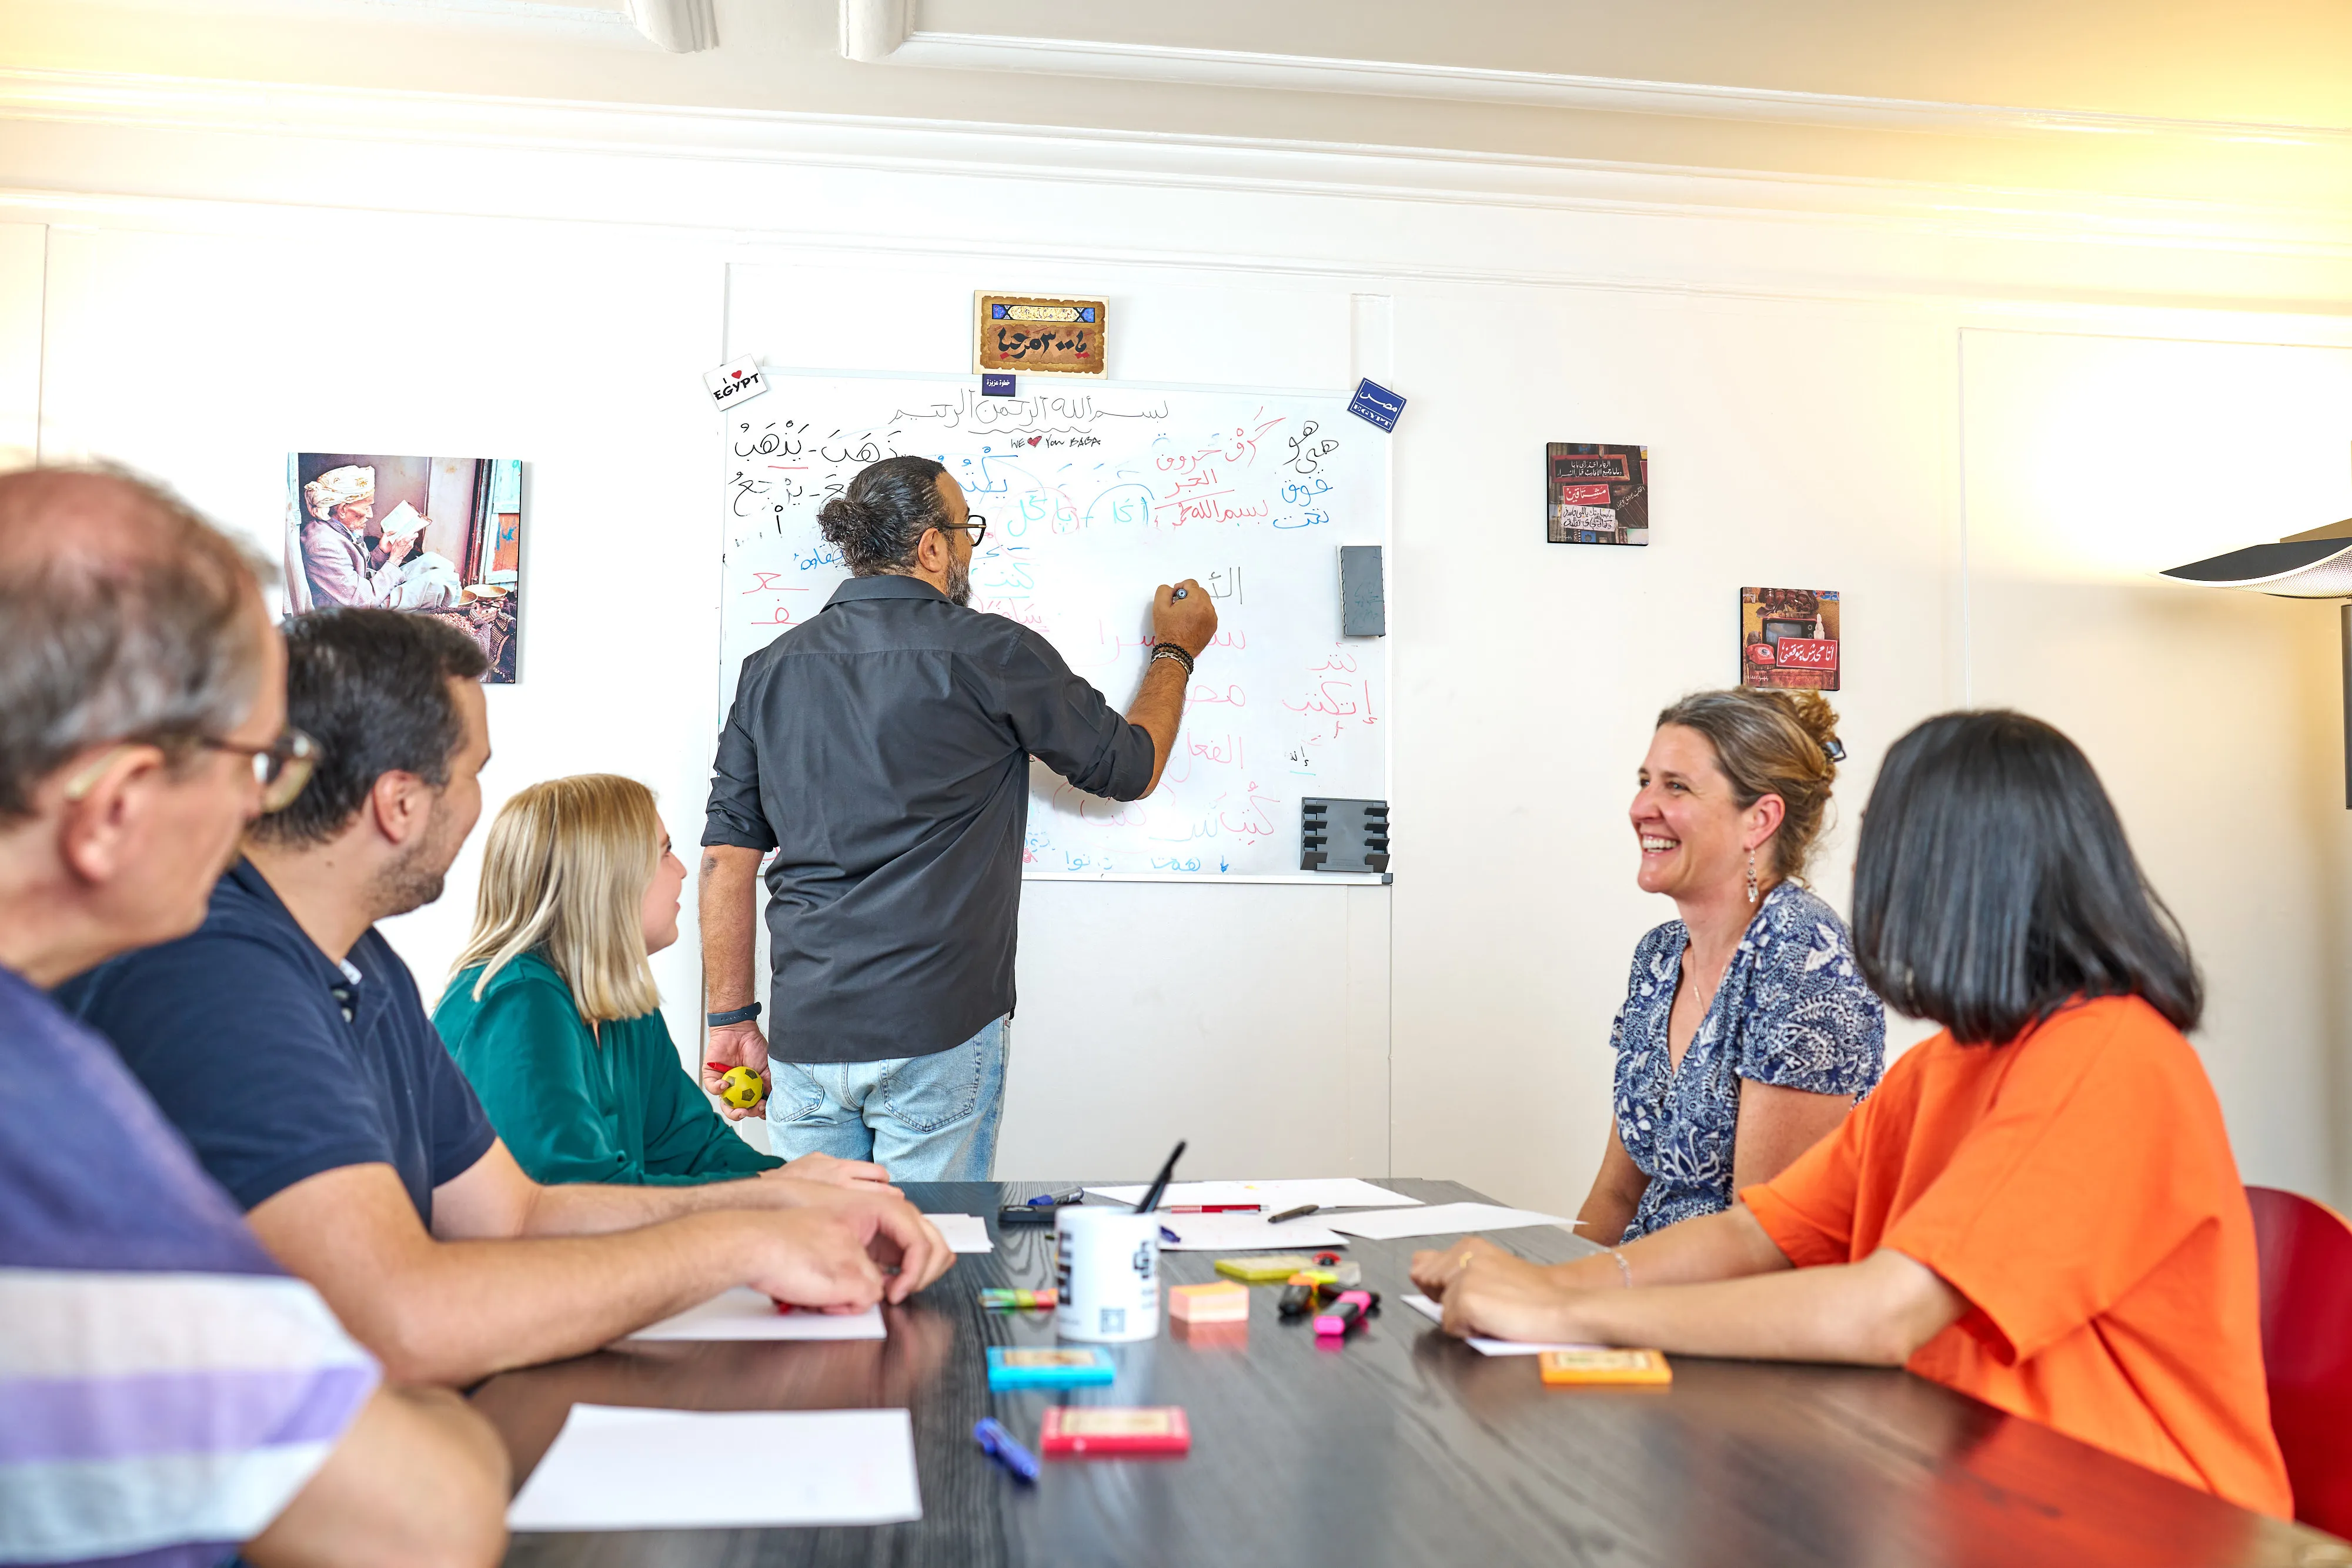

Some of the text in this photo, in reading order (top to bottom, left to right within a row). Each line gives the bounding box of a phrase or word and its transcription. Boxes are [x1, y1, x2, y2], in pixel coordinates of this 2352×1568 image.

[713, 373, 759, 400] EGYPT
[986, 379, 999, 387] عزيزة
[1359, 392, 1398, 413] مصر
[1353, 404, 1392, 426] EGYPT
[1011, 438, 1025, 449] WE
[1069, 436, 1101, 448] BABA
[1282, 420, 1319, 466] هو
[1281, 477, 1334, 507] فوق
[1272, 508, 1329, 529] تحت
